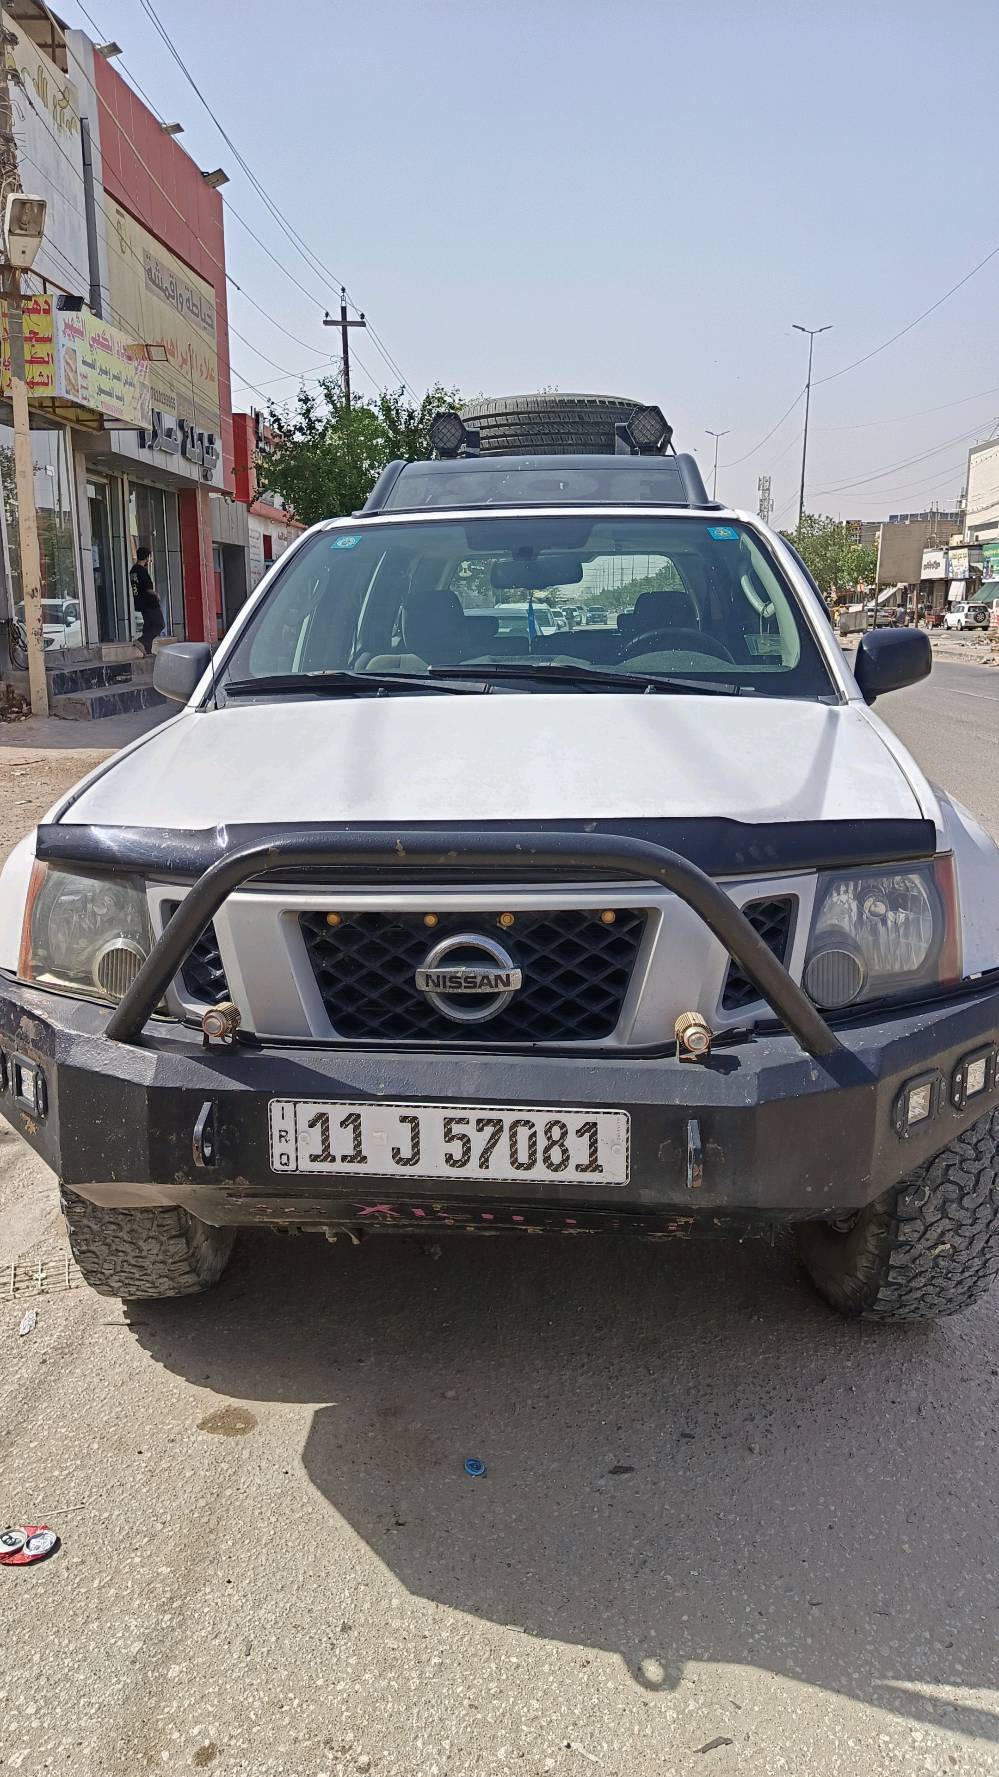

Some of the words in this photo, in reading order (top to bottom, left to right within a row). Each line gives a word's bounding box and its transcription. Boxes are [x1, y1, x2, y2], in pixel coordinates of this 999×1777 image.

[425, 973, 512, 989] NISSAN
[278, 1106, 290, 1166] IRQ
[307, 1112, 368, 1164] 11
[391, 1115, 420, 1166] J
[443, 1117, 604, 1173] 57081
